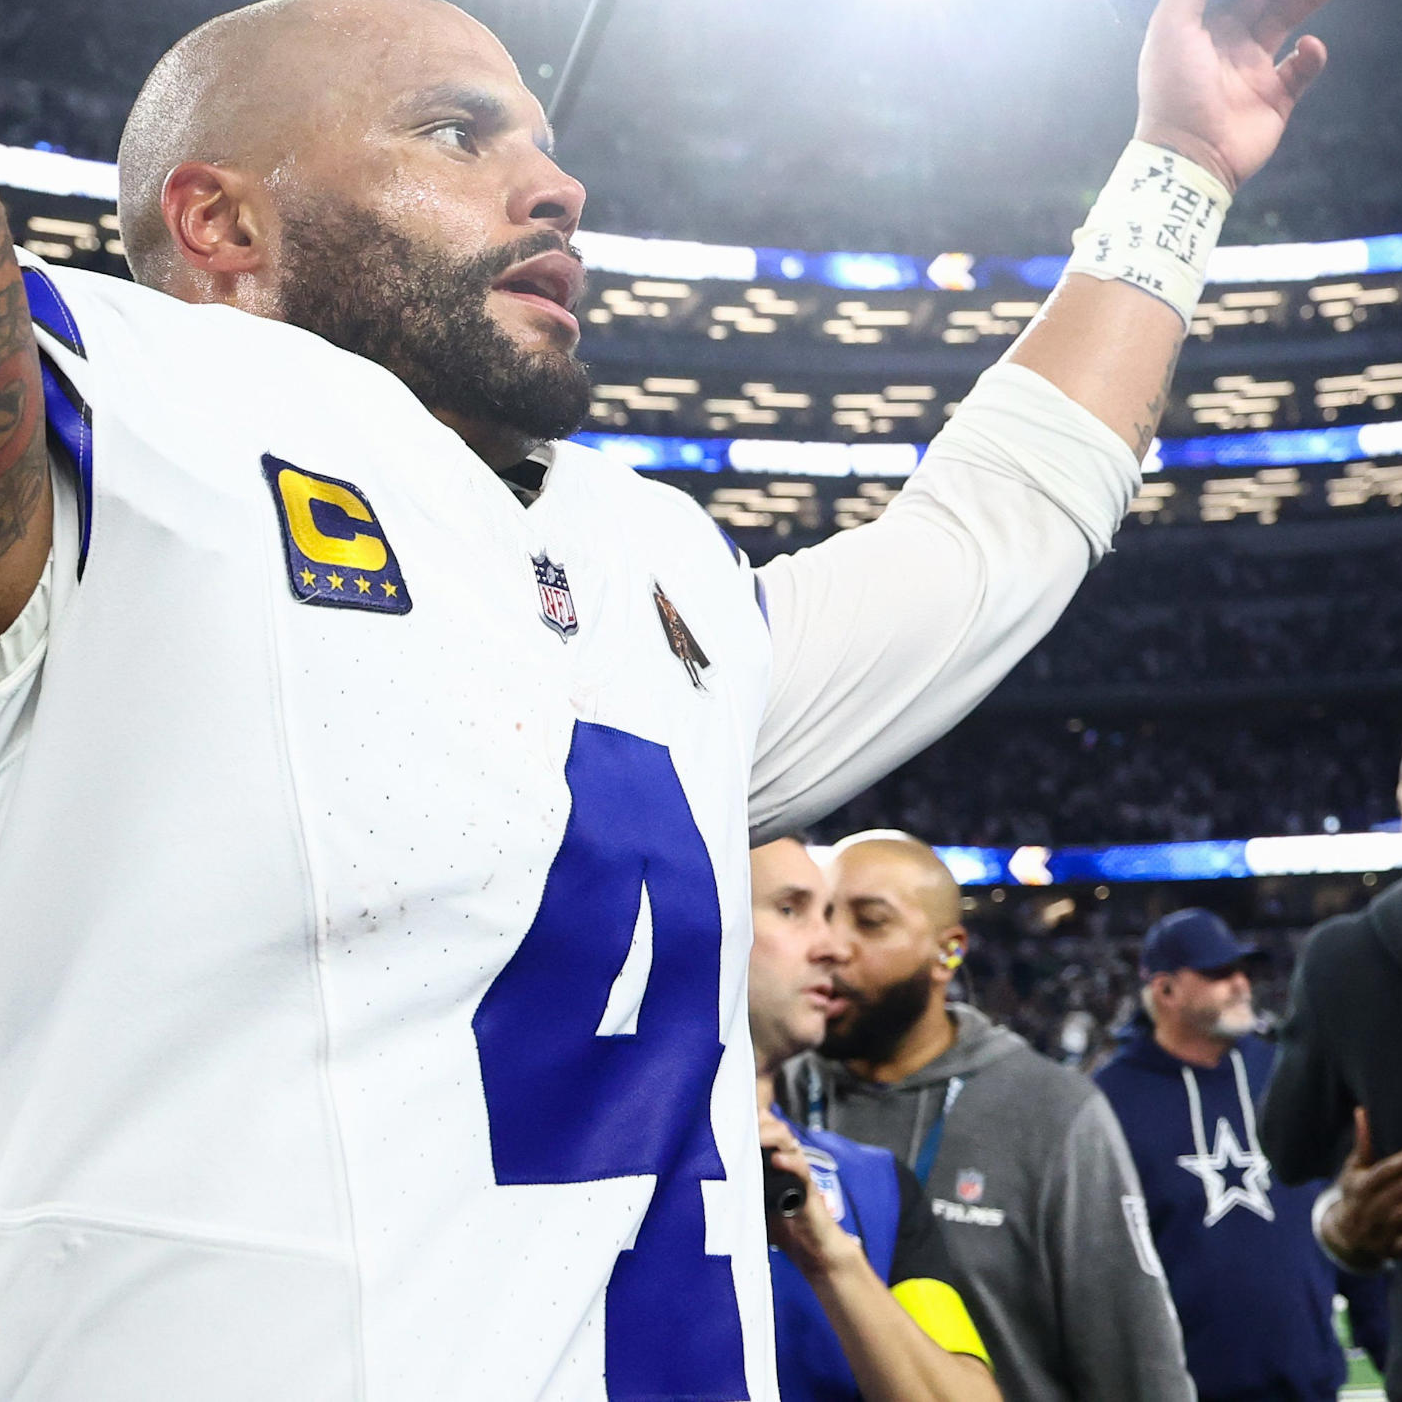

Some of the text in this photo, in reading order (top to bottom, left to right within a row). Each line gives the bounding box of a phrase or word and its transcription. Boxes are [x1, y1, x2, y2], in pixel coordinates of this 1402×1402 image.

[1156, 184, 1202, 252] FAITH
[277, 468, 388, 572] C
[542, 585, 576, 624] NFL
[472, 718, 751, 1402] 4
